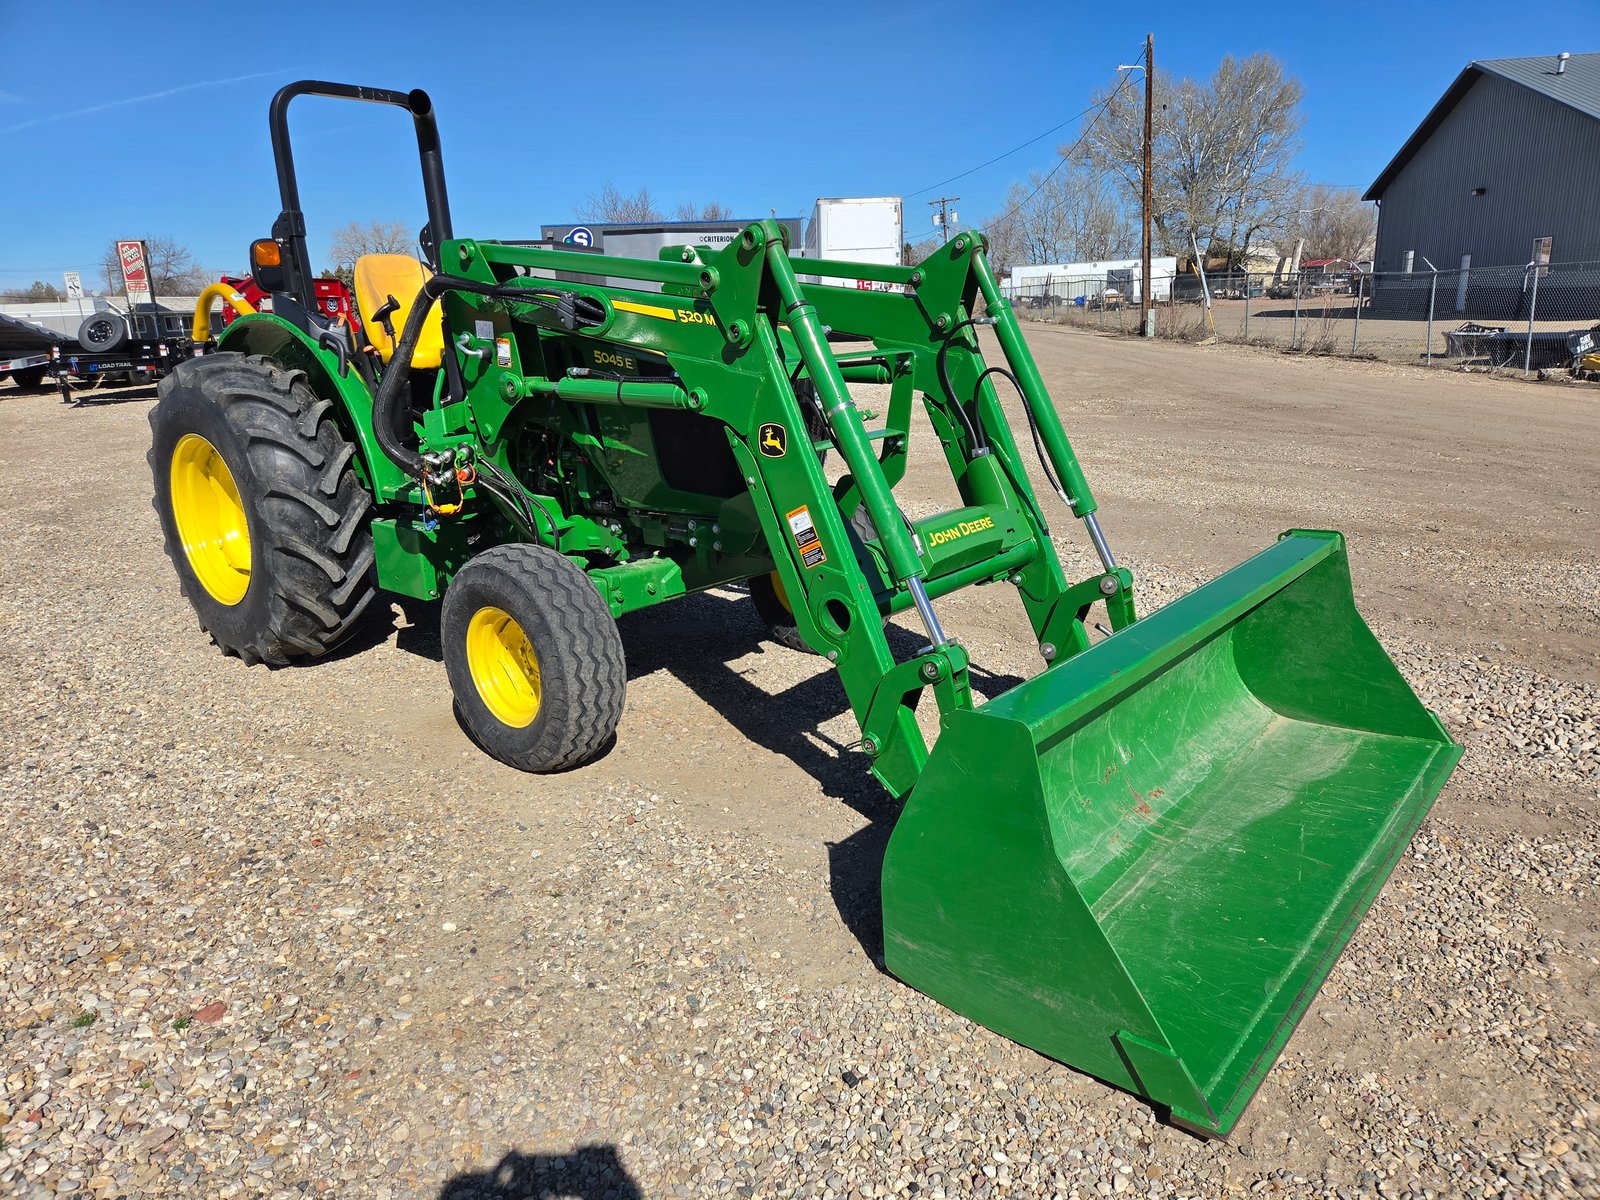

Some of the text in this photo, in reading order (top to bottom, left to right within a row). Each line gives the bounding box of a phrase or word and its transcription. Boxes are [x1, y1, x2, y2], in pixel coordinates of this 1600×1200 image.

[703, 235, 735, 243] CRITERION
[677, 308, 717, 326] 520 M
[593, 349, 634, 370] 5045 E
[929, 516, 995, 547] JOHN DEERE
